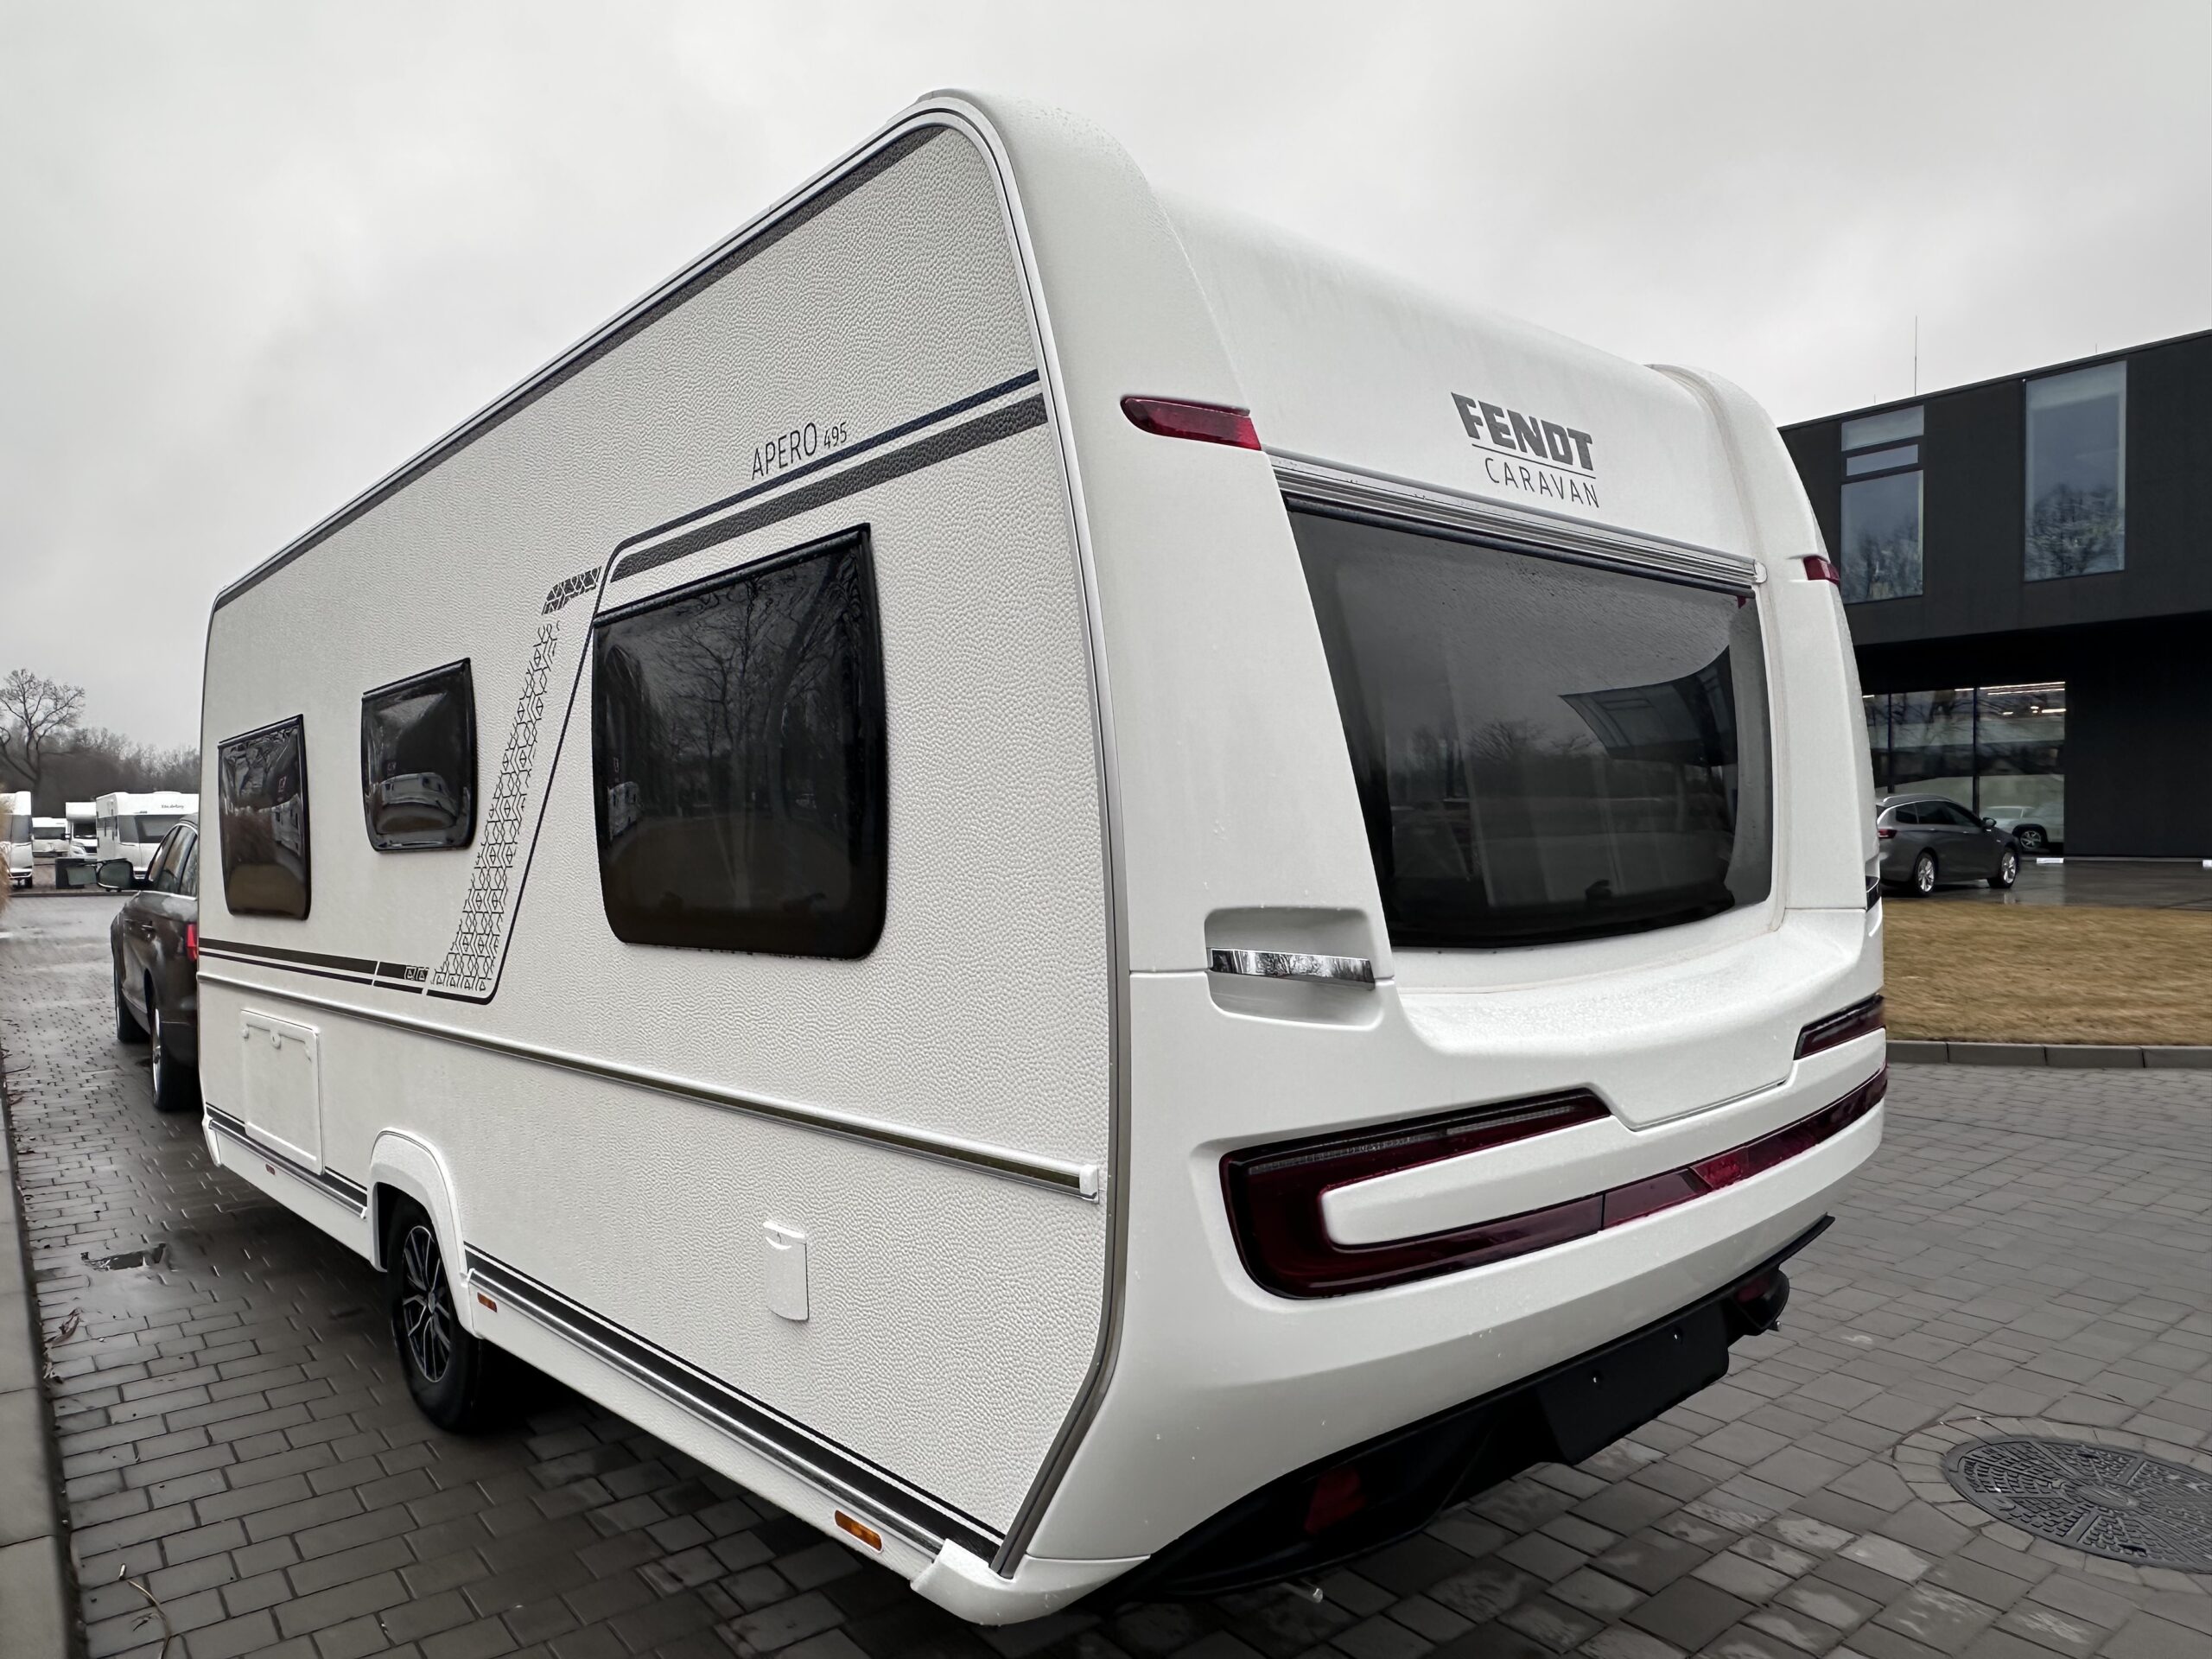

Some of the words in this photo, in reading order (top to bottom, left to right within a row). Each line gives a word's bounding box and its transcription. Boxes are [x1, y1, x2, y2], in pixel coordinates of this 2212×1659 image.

[752, 423, 817, 480] APERO
[823, 422, 848, 448] 495
[1451, 392, 1593, 471] FENDT
[1484, 457, 1599, 508] CARAVAN
